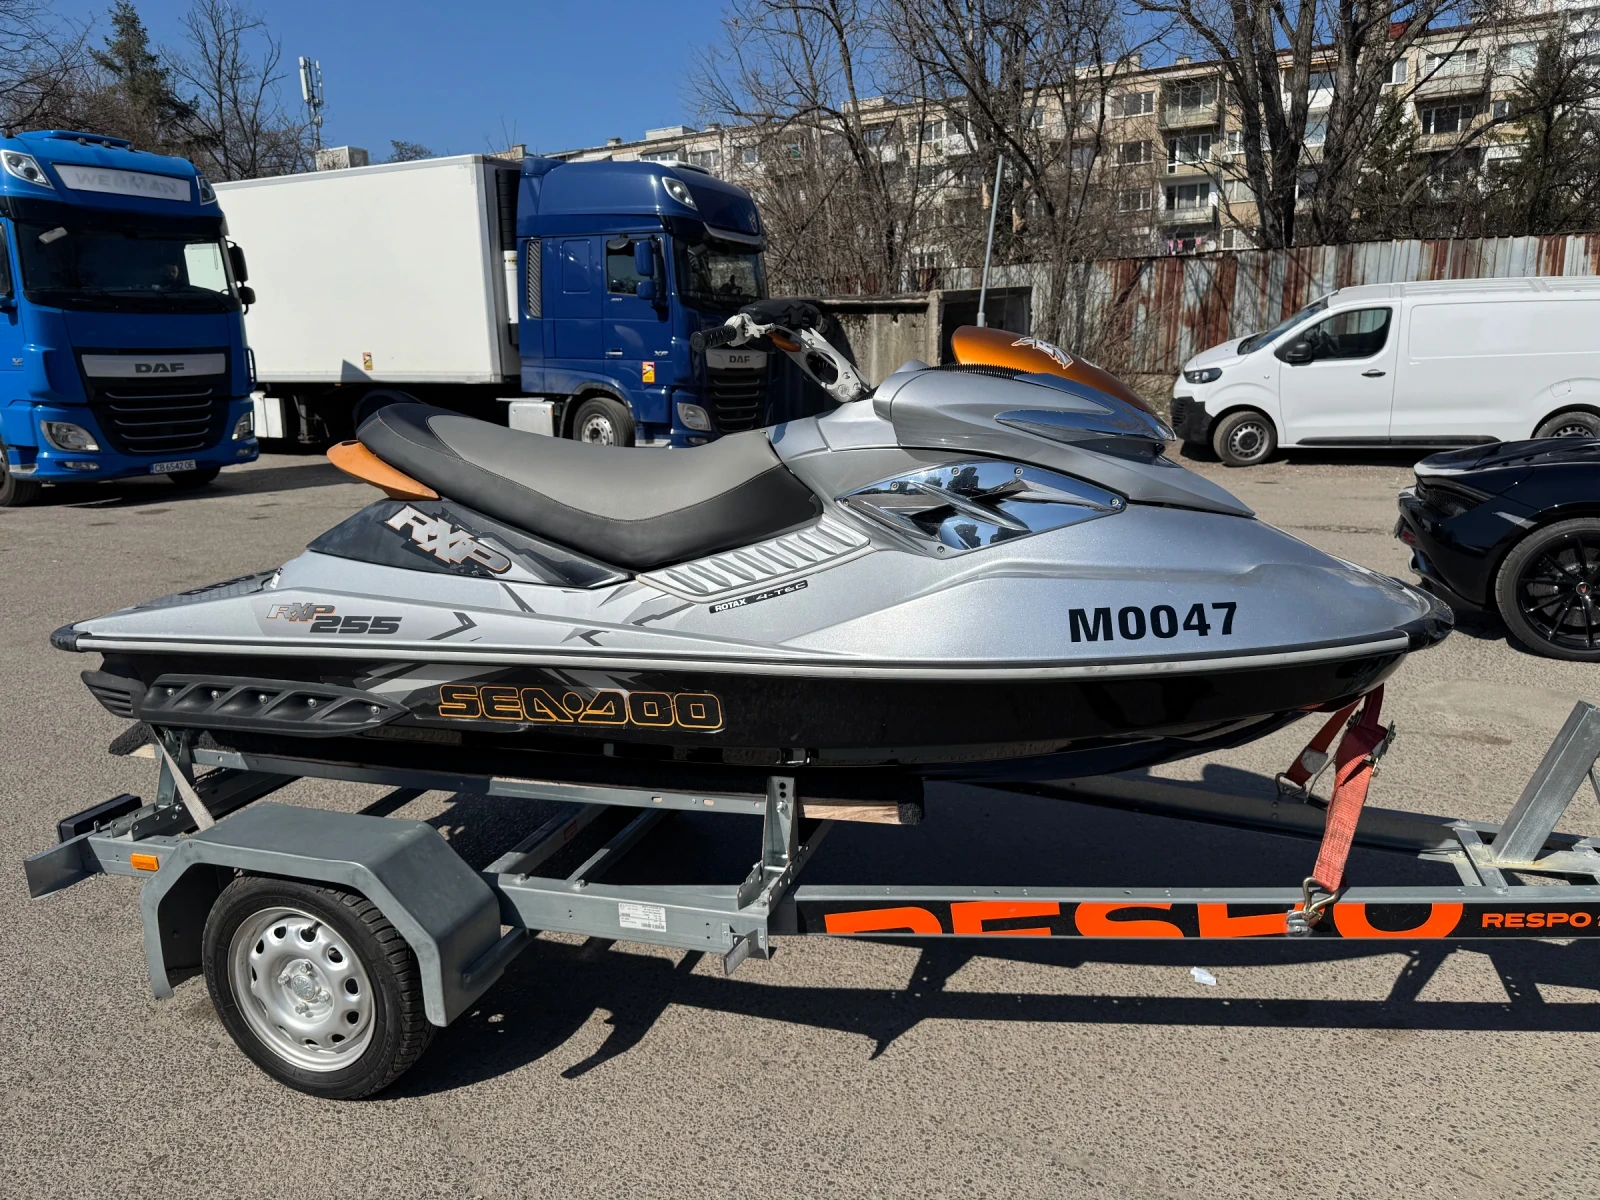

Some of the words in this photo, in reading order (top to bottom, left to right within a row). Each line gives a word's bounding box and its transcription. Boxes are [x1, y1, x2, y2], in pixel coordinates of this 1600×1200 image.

[135, 363, 185, 373] DAF
[729, 355, 750, 364] DAF
[385, 504, 511, 571] RXP
[266, 602, 336, 622] RXP
[714, 598, 747, 612] ROTAX
[309, 615, 403, 635] 255
[1481, 911, 1593, 928] RESPO
